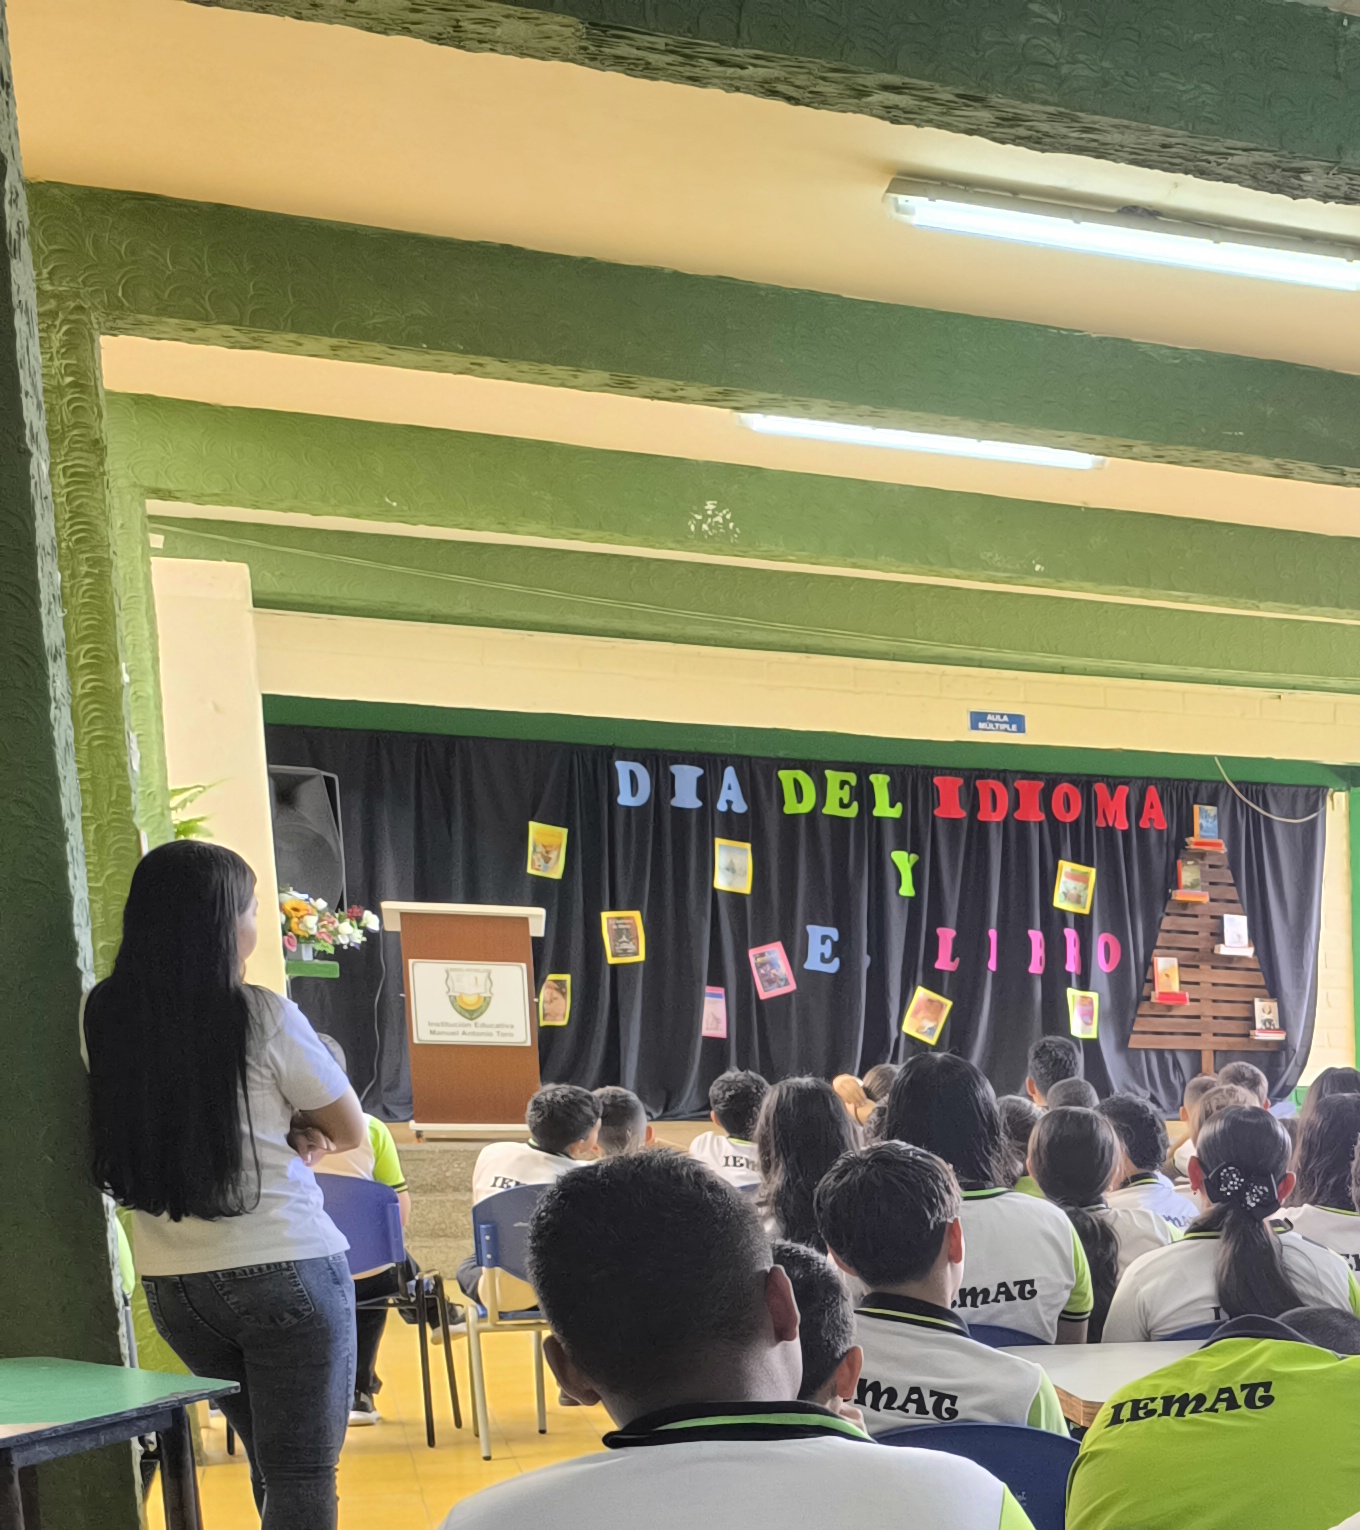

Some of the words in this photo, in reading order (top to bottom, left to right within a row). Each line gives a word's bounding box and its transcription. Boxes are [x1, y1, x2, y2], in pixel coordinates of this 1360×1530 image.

[987, 714, 1009, 722] AULA
[615, 761, 748, 813] DIA
[777, 770, 903, 818] DEL
[933, 776, 1168, 830] IDIOMA
[890, 850, 920, 897] Y
[951, 1278, 1038, 1309] MAT
[854, 1378, 959, 1421] MAT
[1104, 1381, 1275, 1429] IEMAT
